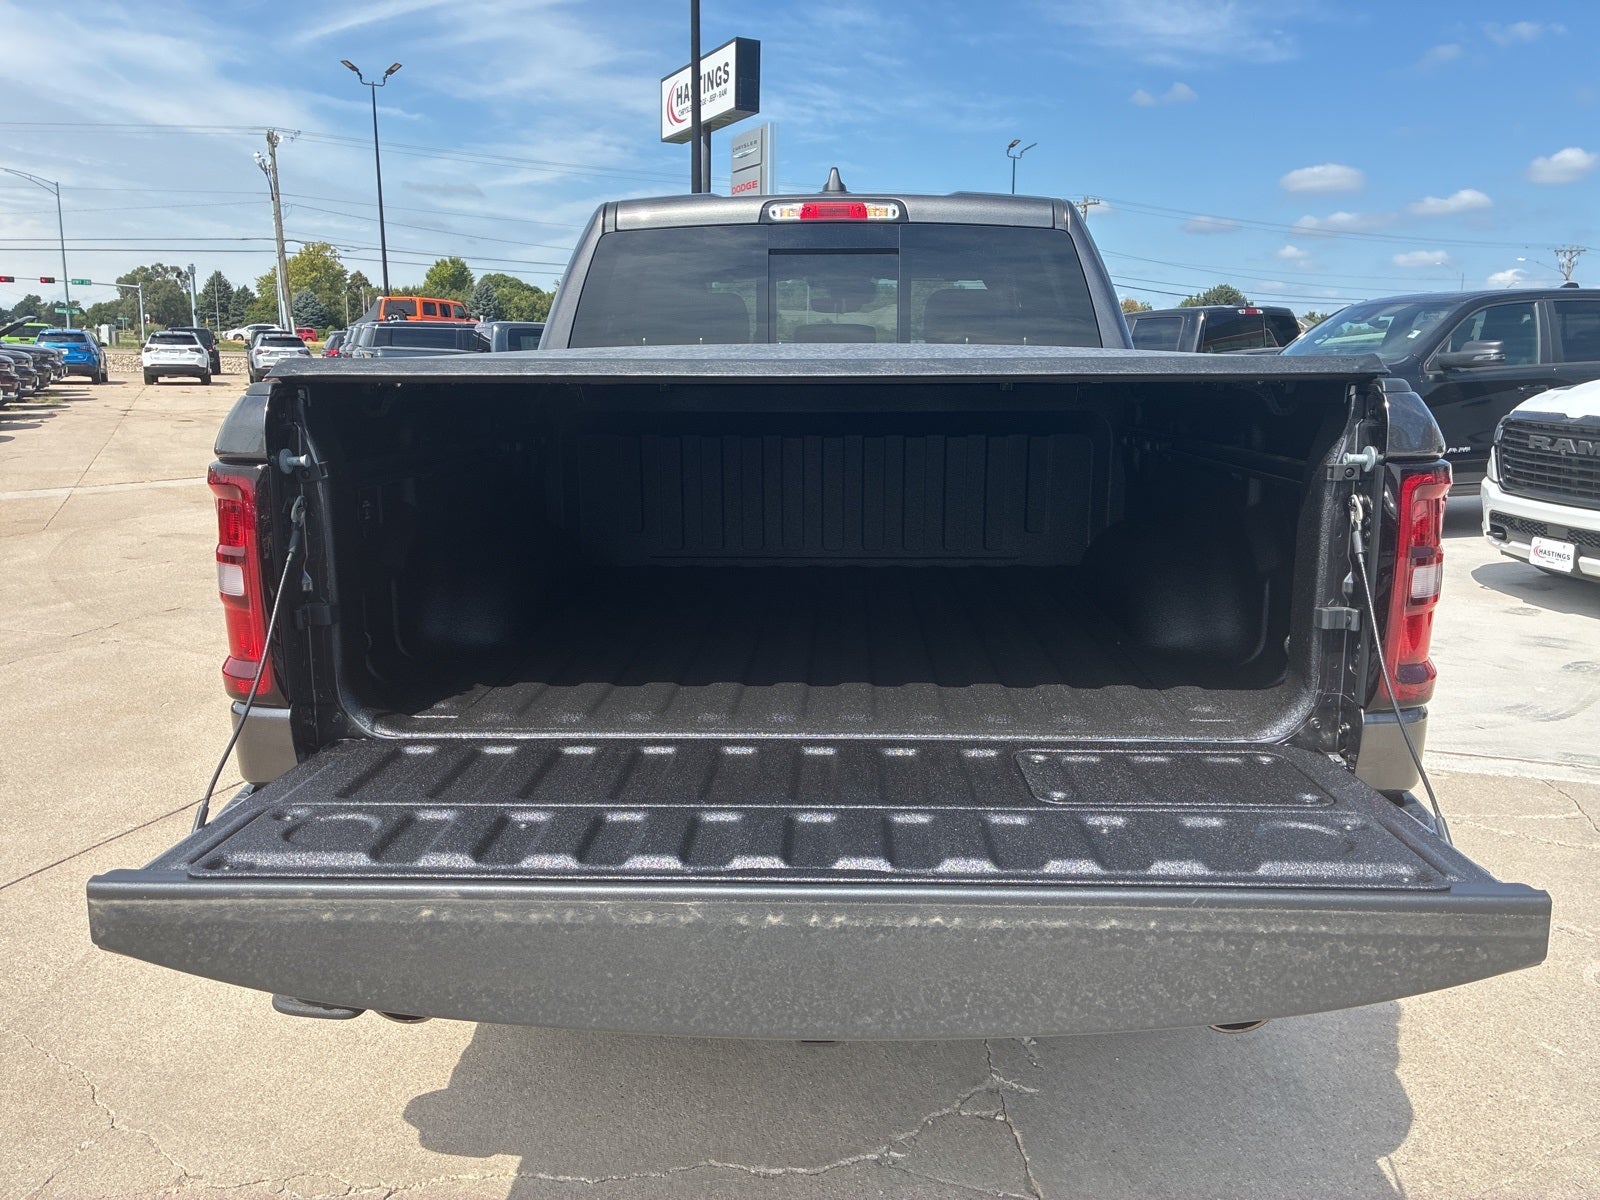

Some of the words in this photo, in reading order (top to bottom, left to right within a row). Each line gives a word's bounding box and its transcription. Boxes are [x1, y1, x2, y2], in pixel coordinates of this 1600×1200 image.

[676, 61, 729, 107] HAINGS
[732, 139, 758, 153] CHRYSLER
[731, 180, 758, 195] DODGE
[1528, 434, 1600, 456] RAM
[1538, 548, 1571, 561] HASTINGS
